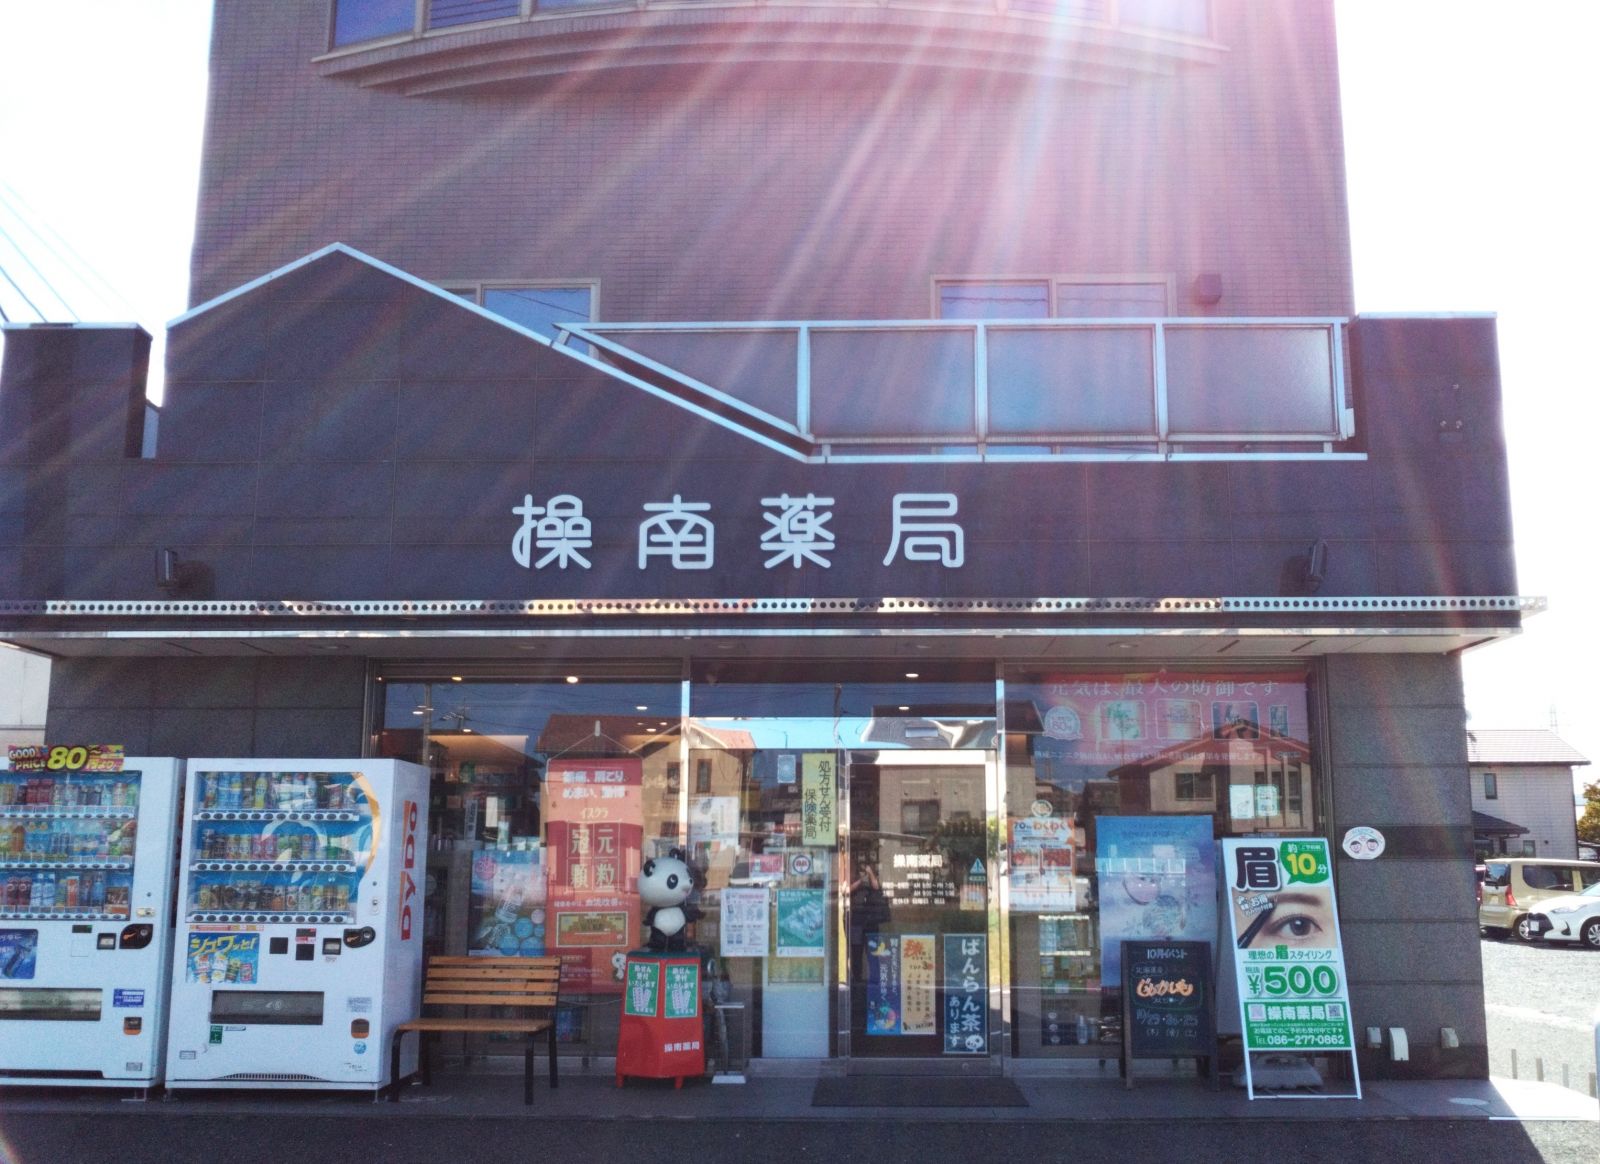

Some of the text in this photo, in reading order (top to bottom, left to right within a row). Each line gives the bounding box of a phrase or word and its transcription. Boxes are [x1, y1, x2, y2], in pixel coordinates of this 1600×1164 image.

[512, 493, 965, 570] 操南薬局
[8, 747, 36, 759] GOOD
[47, 745, 89, 770] 80
[818, 760, 832, 833] 処方せん受付
[580, 807, 609, 819] イスクラ
[804, 788, 817, 840] 保険薬局
[1235, 847, 1279, 890] 眉
[1286, 852, 1327, 876] 10分
[1248, 944, 1332, 960] 理想の眉スタイリング
[961, 939, 980, 1032] ばんらん茶
[1247, 965, 1338, 995] ¥500
[949, 996, 960, 1047] あります
[1267, 1005, 1325, 1020] 操南薬局
[1267, 1034, 1345, 1045] 086-277-0862
